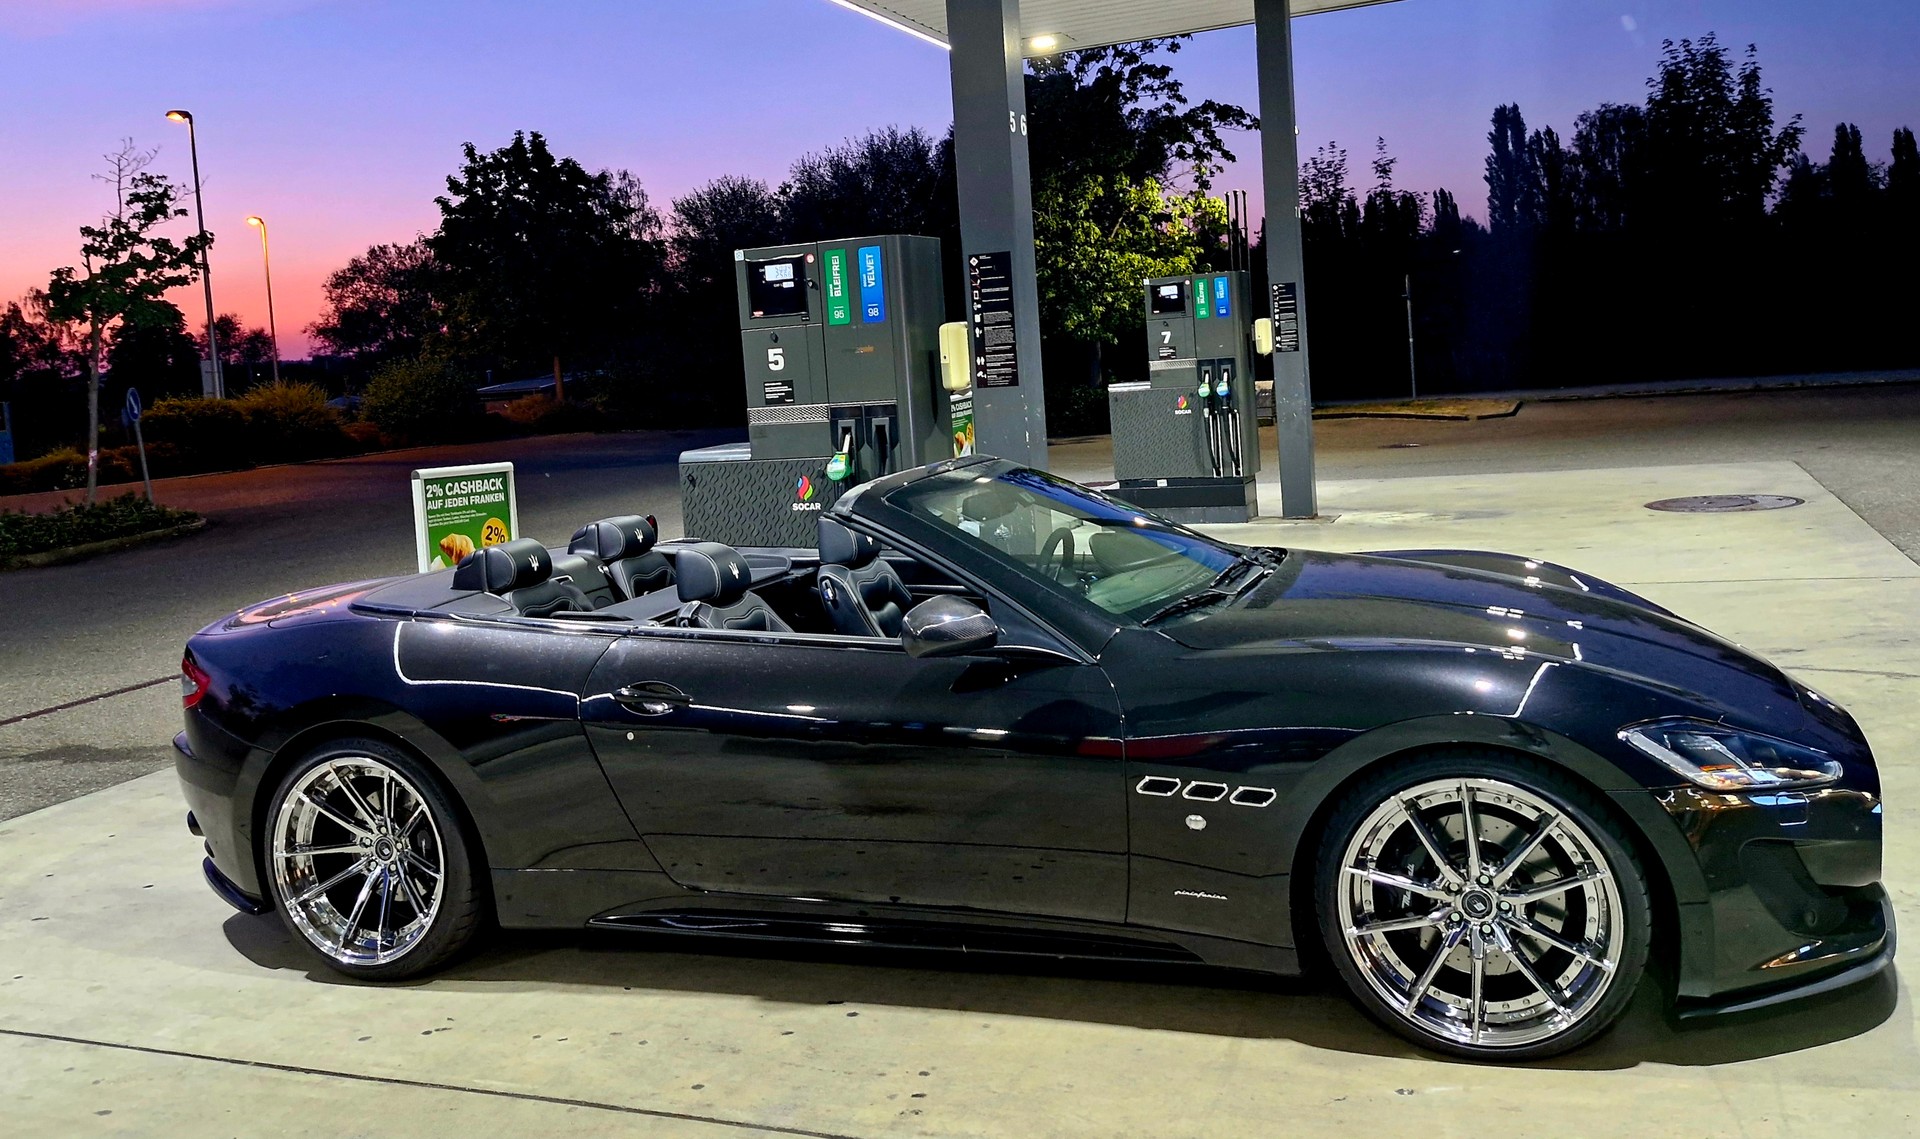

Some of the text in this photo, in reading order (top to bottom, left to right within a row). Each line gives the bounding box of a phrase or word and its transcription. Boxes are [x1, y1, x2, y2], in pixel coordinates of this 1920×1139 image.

[1009, 110, 1027, 136] 5 6
[831, 255, 842, 297] BLEIFREI
[865, 253, 876, 288] VELVET
[833, 309, 845, 319] 95
[867, 307, 879, 317] 98
[1160, 331, 1171, 344] 7
[767, 347, 785, 371] 5
[425, 477, 504, 498] 2% CASHBACK
[427, 492, 505, 510] AUF JEDEN FRANKEN
[792, 502, 821, 511] SOCAR
[485, 525, 506, 544] 2%
